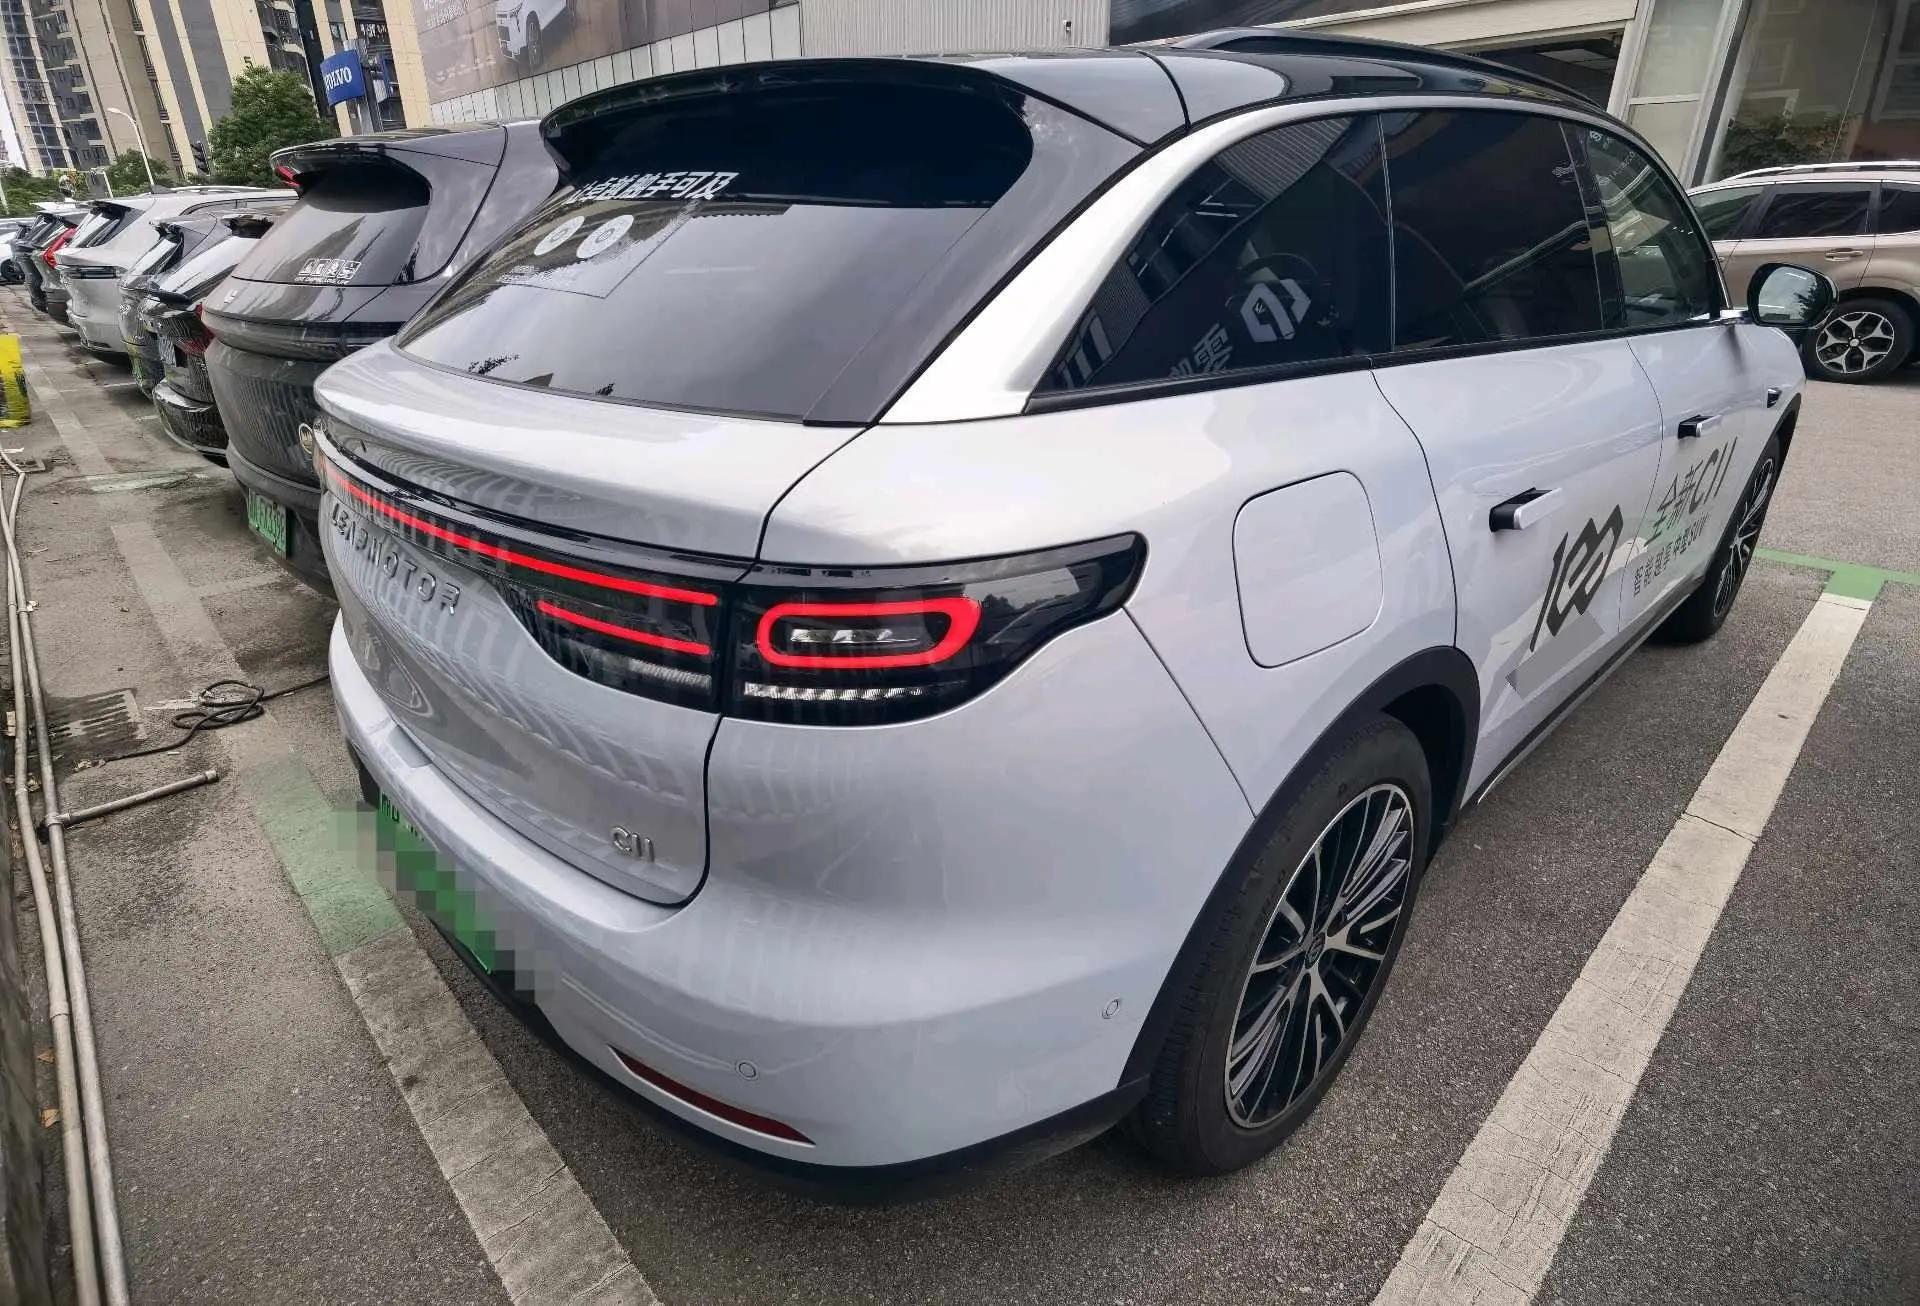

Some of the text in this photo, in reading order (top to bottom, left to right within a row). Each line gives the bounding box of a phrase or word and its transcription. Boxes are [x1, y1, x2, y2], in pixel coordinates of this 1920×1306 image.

[1643, 436, 1738, 547] 全新C11
[332, 503, 460, 616] LEAPMOTOR
[612, 826, 656, 863] C11
